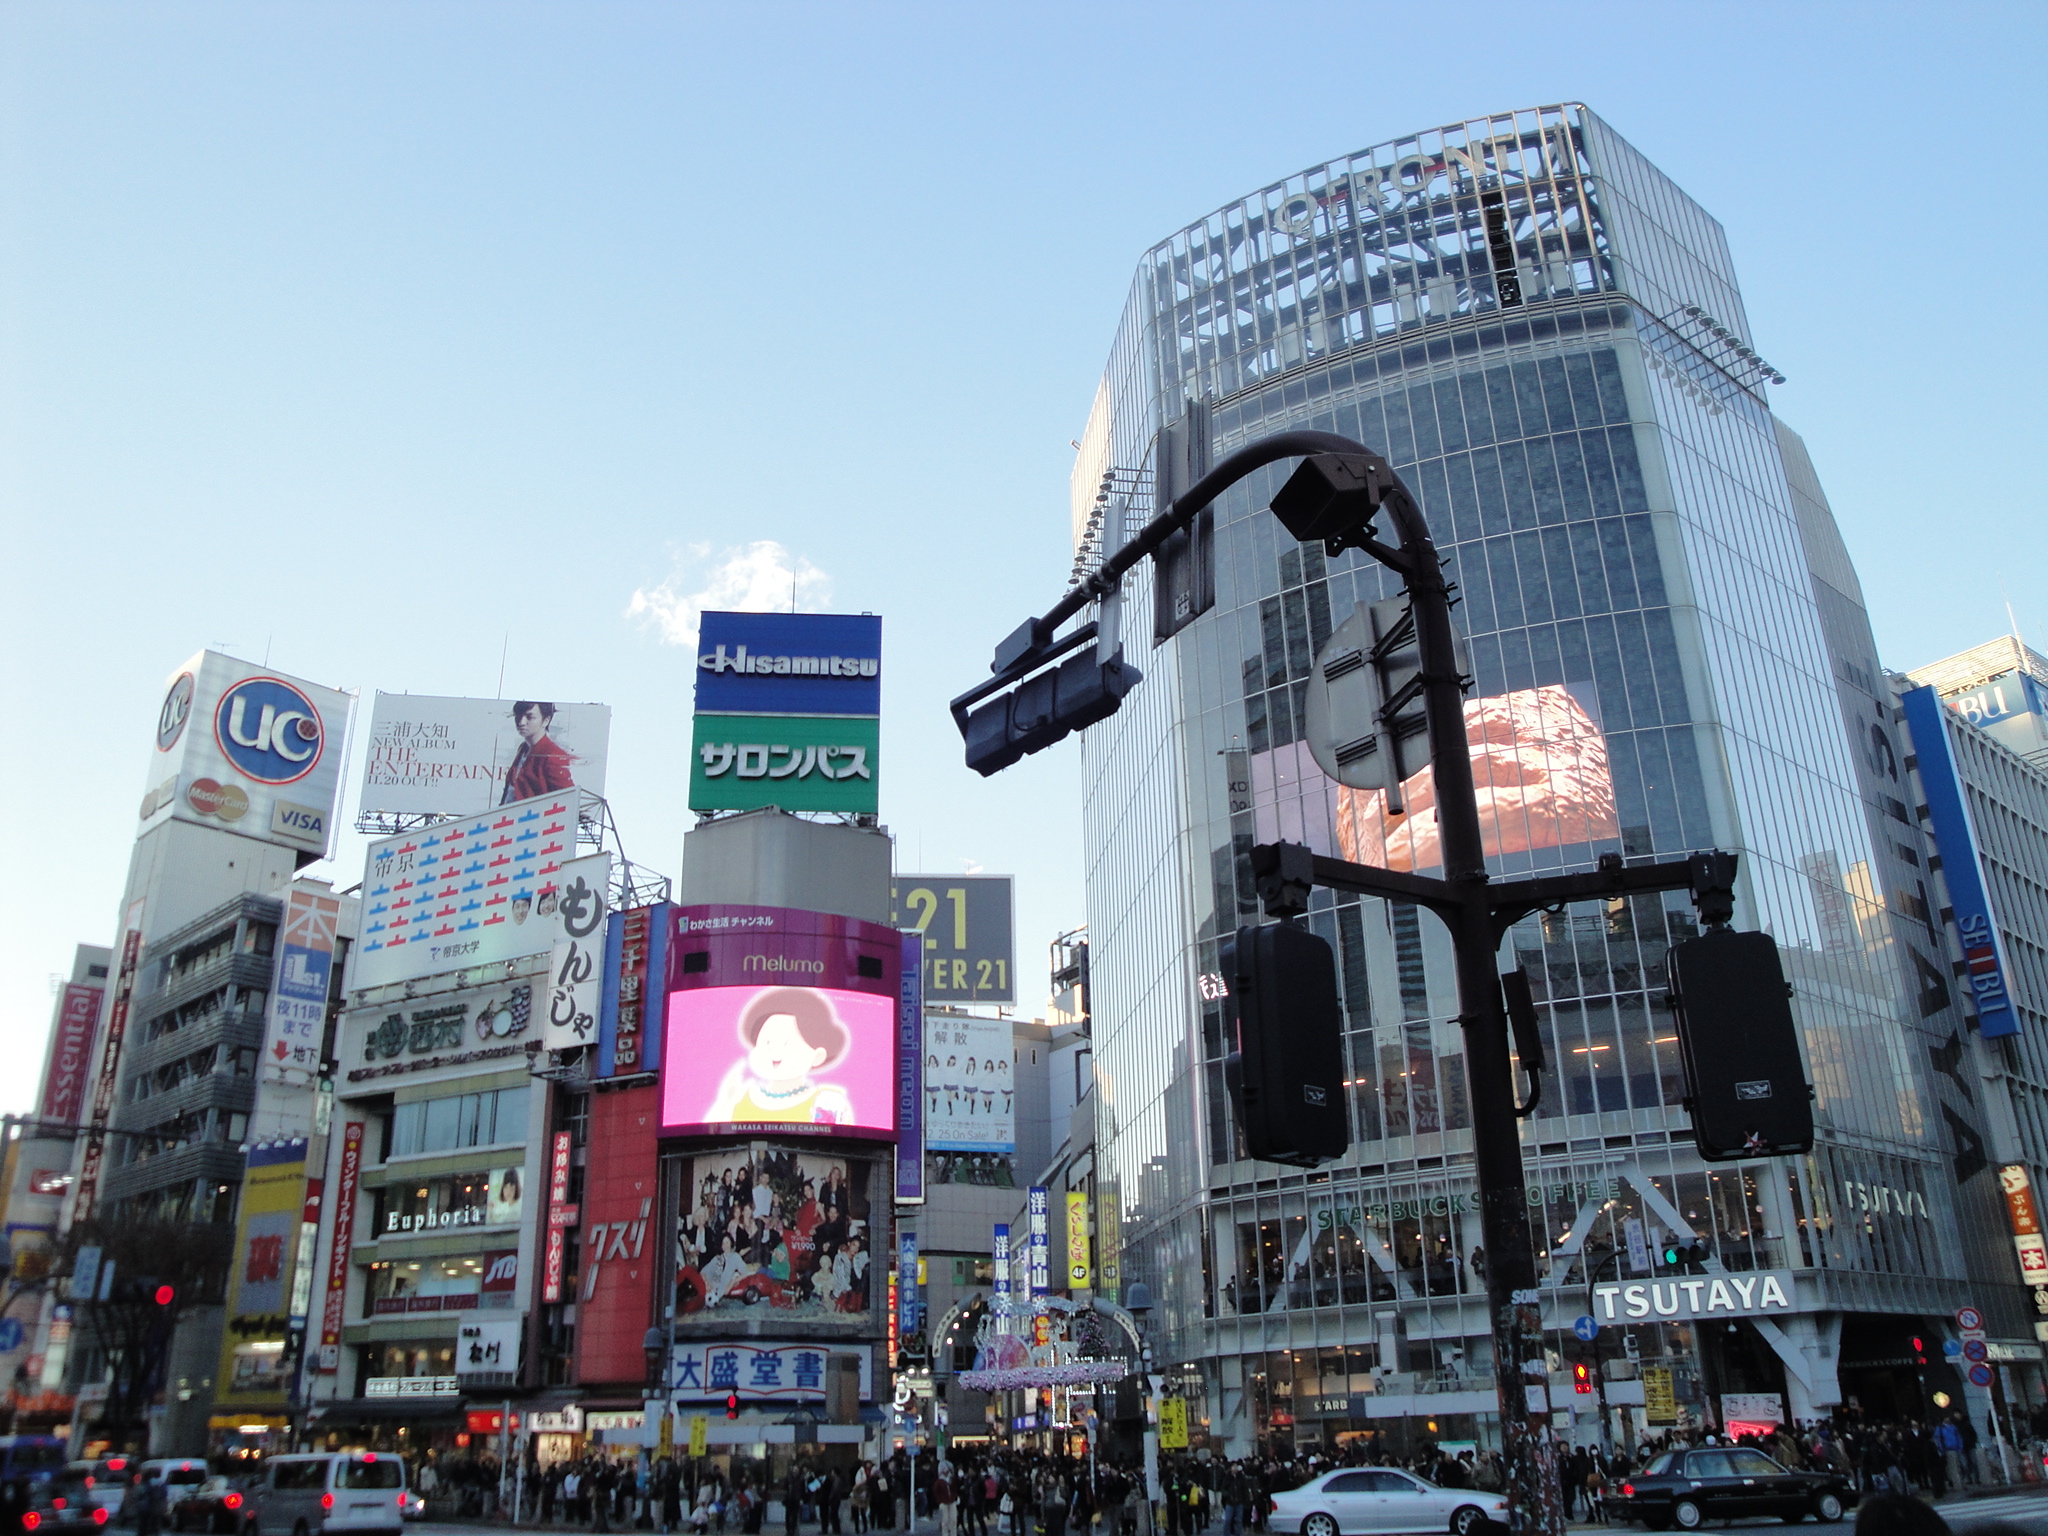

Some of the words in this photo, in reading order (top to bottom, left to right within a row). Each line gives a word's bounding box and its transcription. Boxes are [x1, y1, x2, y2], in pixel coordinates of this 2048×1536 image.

[699, 644, 878, 676] Hisamitsu
[376, 720, 449, 739] 三浦大知
[372, 746, 418, 763] THE
[373, 736, 407, 748] NEW
[408, 738, 456, 750] ALBUM
[700, 742, 870, 779] サロンパス
[367, 774, 399, 785] 11.20
[188, 787, 249, 811] MasterCard
[281, 810, 323, 834] VISA
[374, 851, 415, 880] 帝京
[285, 896, 339, 949] 本
[690, 916, 729, 931] わかさ生活
[731, 915, 774, 927] チャンネル
[442, 940, 480, 958] 帝京大学
[549, 875, 603, 1040] もんじゃ
[743, 954, 825, 974] melumo
[925, 958, 968, 990] ER
[976, 959, 1007, 991] 21
[1959, 912, 2007, 1017] SEIBU
[614, 909, 644, 1066] 三千里薬品
[276, 1000, 322, 1022] 夜11時
[282, 1019, 312, 1036] まで
[934, 1030, 968, 1046] 解散
[43, 985, 91, 1120] Essential
[292, 1044, 318, 1063] 地下
[731, 1123, 760, 1133] WAKASA
[763, 1123, 796, 1133] SEIKATSU
[798, 1123, 832, 1133] CHANNEL
[1317, 1192, 1481, 1230] STARBUCKS
[1526, 1178, 1621, 1206] OFFEE
[1845, 1180, 1929, 1220] TSUTAYA
[387, 1204, 481, 1234] Euphoria
[1030, 1191, 1048, 1288] 洋服の青山
[485, 1254, 517, 1284] JTB
[1072, 1267, 1085, 1277] 4F
[2023, 1249, 2045, 1270] 本
[1595, 1275, 1789, 1320] TSUTAYA
[675, 1351, 863, 1390] 大盛堂書
